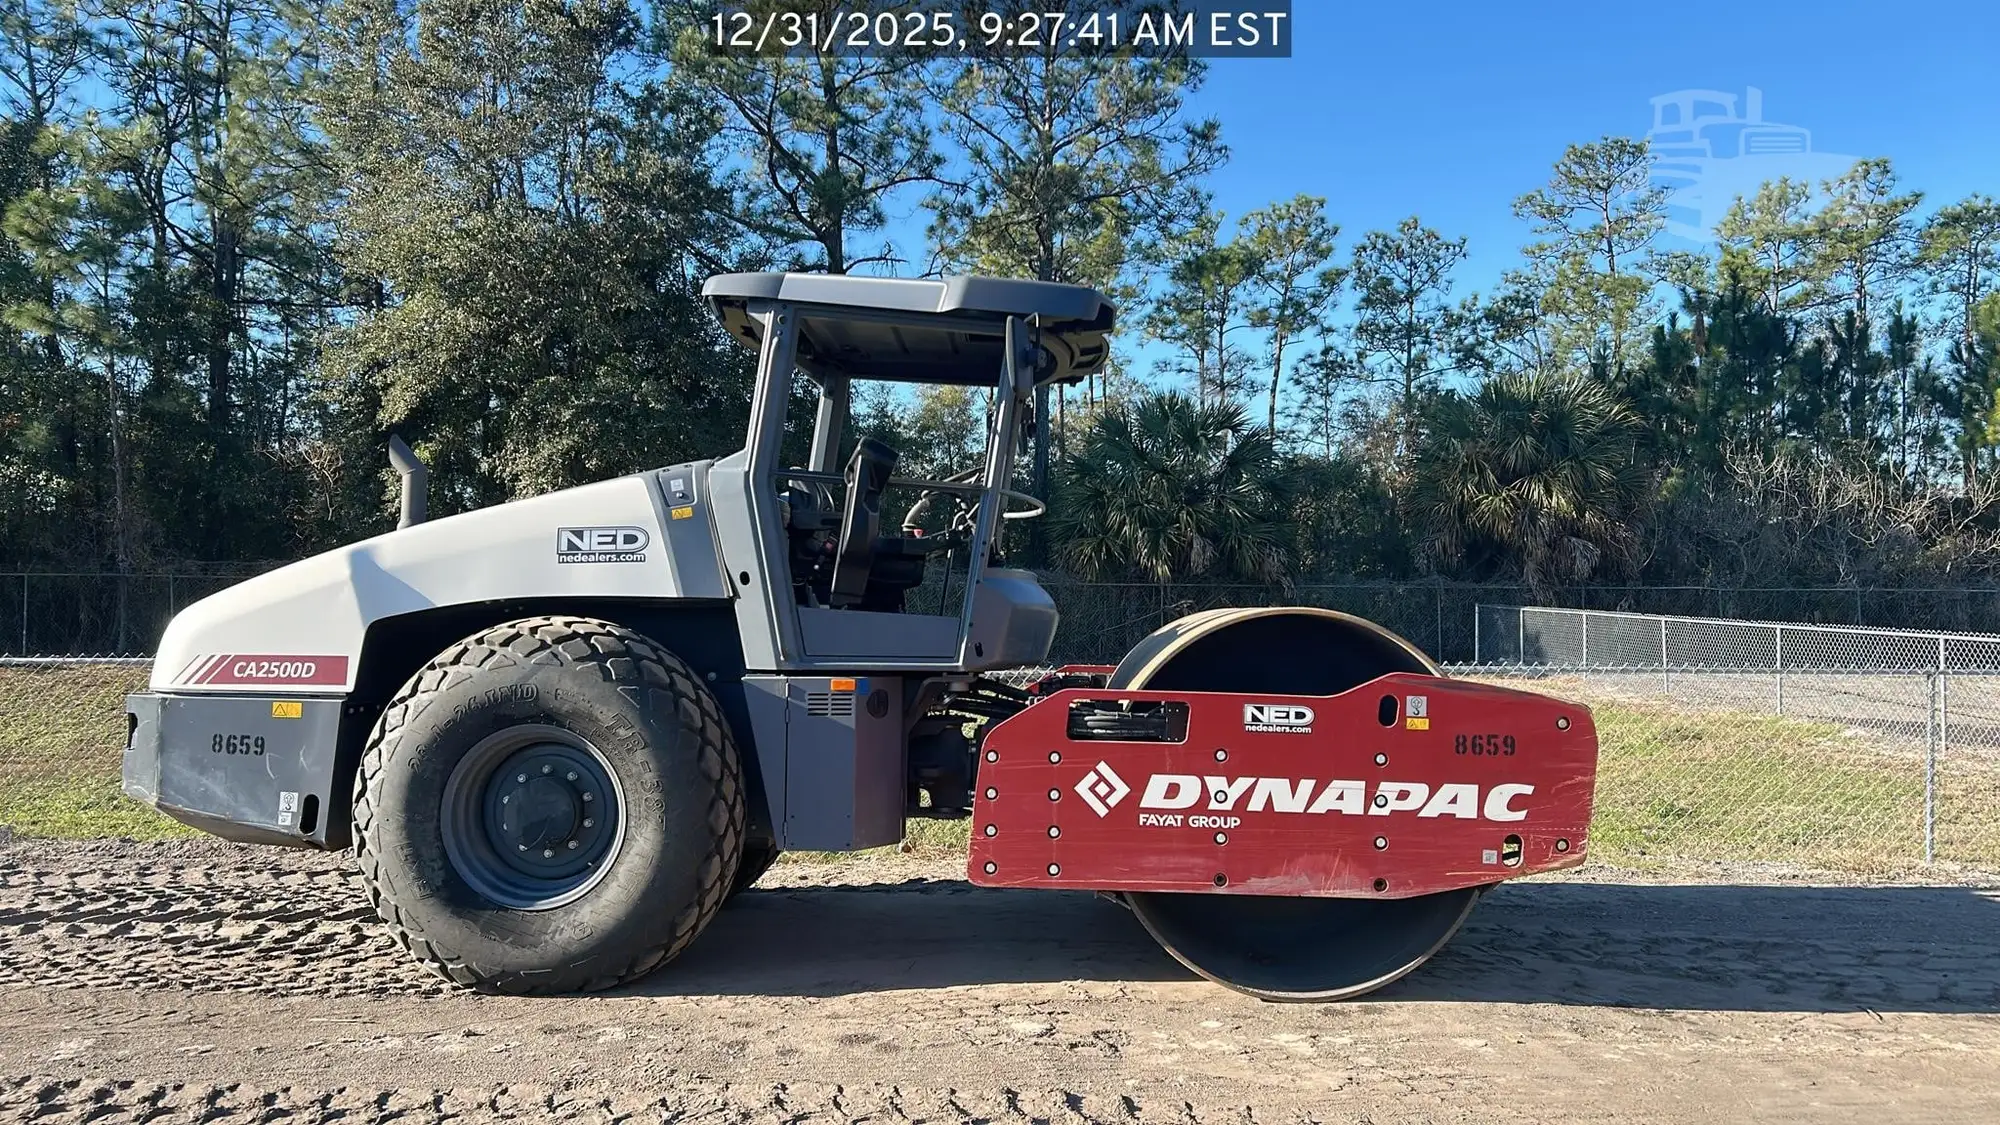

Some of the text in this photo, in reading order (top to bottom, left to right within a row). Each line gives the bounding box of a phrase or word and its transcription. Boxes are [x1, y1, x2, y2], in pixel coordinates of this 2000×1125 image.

[560, 528, 648, 551] NED
[558, 553, 645, 563] nedealers.com
[233, 661, 316, 678] CA2500D
[1246, 706, 1313, 724] NED
[1245, 724, 1312, 733] nedealers.com
[211, 733, 266, 756] 8659
[1454, 734, 1516, 756] 8659
[1139, 774, 1535, 822] DYNAPAC
[1139, 813, 1241, 829] FAYAT GROUP
